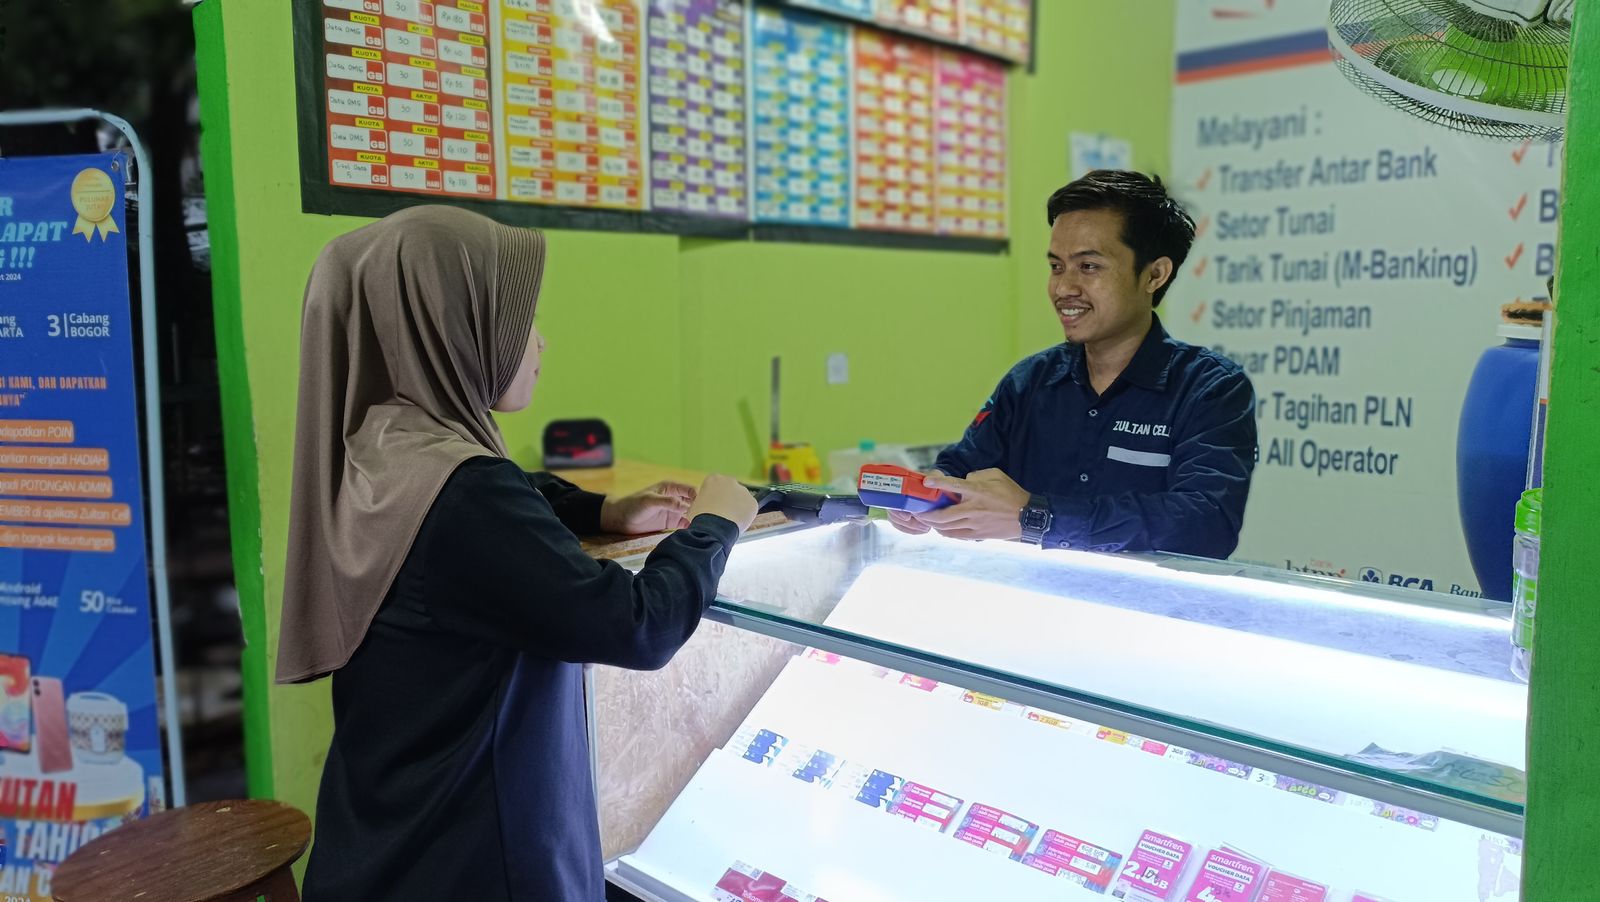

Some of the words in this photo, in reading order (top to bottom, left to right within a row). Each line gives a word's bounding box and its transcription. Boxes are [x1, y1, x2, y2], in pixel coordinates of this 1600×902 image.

[364, 2, 379, 12] GB
[354, 15, 376, 23] KUOTA
[326, 23, 342, 32] Data
[366, 36, 381, 46] GB
[356, 50, 377, 58] KUOTA
[367, 71, 383, 81] GB
[356, 85, 379, 93] KUOTA
[474, 87, 486, 97] RB
[368, 106, 384, 115] GB
[424, 114, 438, 122] HARI
[476, 120, 488, 130] RB
[1196, 106, 1307, 151] Melayani
[370, 140, 386, 149] GB
[425, 147, 439, 156] HARI
[476, 152, 489, 161] RB
[1219, 160, 1303, 196] Transfer
[1308, 156, 1369, 187] Antar
[1378, 147, 1438, 181] Bank
[372, 175, 387, 184] GB
[426, 180, 440, 189] HARI
[477, 183, 490, 192] RB
[1215, 210, 1269, 241] Setor
[1274, 205, 1336, 237] Tunai
[1215, 254, 1263, 284] Tarik
[1271, 248, 1328, 282] Tunai
[1333, 245, 1478, 288] (M-Banking)
[5, 273, 21, 281] 2024
[69, 313, 110, 327] Cabang
[1211, 300, 1265, 330] Setor
[1271, 300, 1371, 336] Pinjaman
[47, 314, 61, 337] 3
[71, 326, 110, 337] BOGOR
[1274, 345, 1340, 376] PDAM
[39, 377, 57, 389] DAN
[60, 377, 107, 389] DAPATKAN
[1272, 391, 1357, 430] Tagihan
[1364, 397, 1413, 428] PLN
[48, 425, 73, 438] POIN
[1113, 420, 1151, 436] ZULTAN
[30, 453, 68, 468] menjadi
[69, 455, 107, 466] HADIAH
[1266, 437, 1295, 466] All
[1300, 440, 1398, 477] Operator
[20, 479, 76, 491] POTONGAN
[78, 481, 112, 493] ADMIN
[32, 507, 41, 518] di
[43, 507, 78, 521] aplikasi
[79, 508, 110, 519] Zultan
[21, 532, 56, 547] banyak
[1450, 584, 1487, 599] Ban
[80, 589, 105, 612] 50
[1141, 842, 1166, 855] VOUCHER
[1165, 850, 1180, 860] DATA
[1207, 863, 1235, 877] VOUCHER
[1234, 872, 1251, 882] DATA
